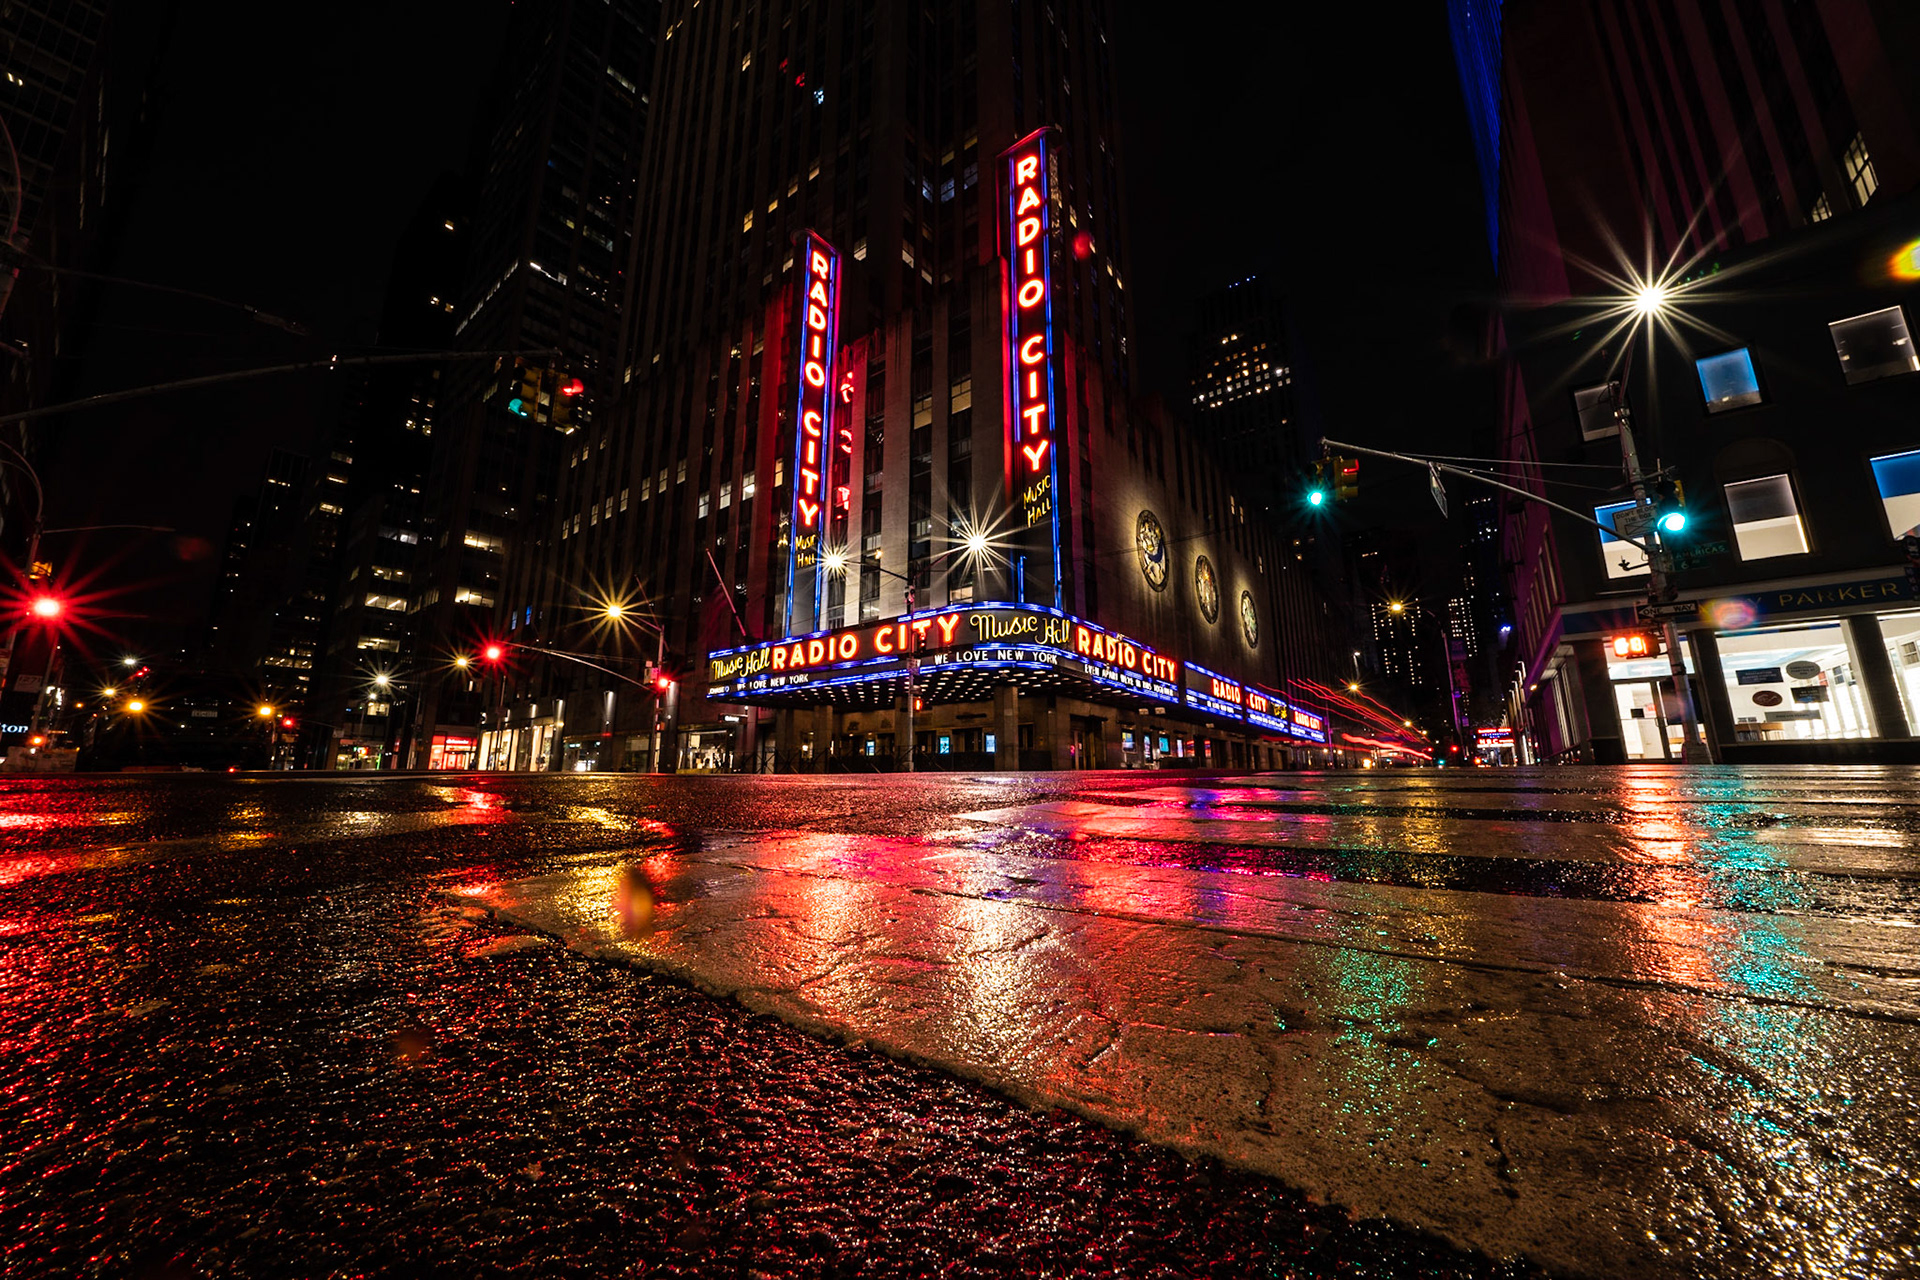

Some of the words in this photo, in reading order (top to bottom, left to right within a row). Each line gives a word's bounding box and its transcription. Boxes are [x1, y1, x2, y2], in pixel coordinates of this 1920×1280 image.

[1017, 155, 1045, 308] RADIO
[804, 251, 829, 387] RADIO
[1020, 334, 1049, 472] CITY
[798, 410, 822, 527] CITY
[1616, 509, 1635, 519] DON'T
[1675, 544, 1726, 559] AERICAS
[1681, 560, 1690, 570] 6
[1643, 606, 1663, 617] ONE
[1673, 603, 1693, 613] WAY
[1778, 582, 1900, 607] PARKER
[772, 632, 860, 670] RADIO
[873, 613, 960, 654] CITY
[970, 613, 1039, 642] Music
[1034, 617, 1071, 645] Hall
[711, 656, 744, 681] Music
[739, 646, 771, 678] Hall
[934, 653, 949, 665] WE
[956, 650, 989, 663] LOVE
[997, 649, 1025, 661] NEW
[1032, 650, 1058, 666] YORK
[1075, 625, 1137, 669] RADIO
[1141, 650, 1178, 682] CITY
[770, 676, 786, 687] NEW
[789, 673, 809, 685] YORK
[1212, 677, 1242, 705] RADIO
[1248, 691, 1268, 713] CITY
[0, 721, 29, 734] ton
